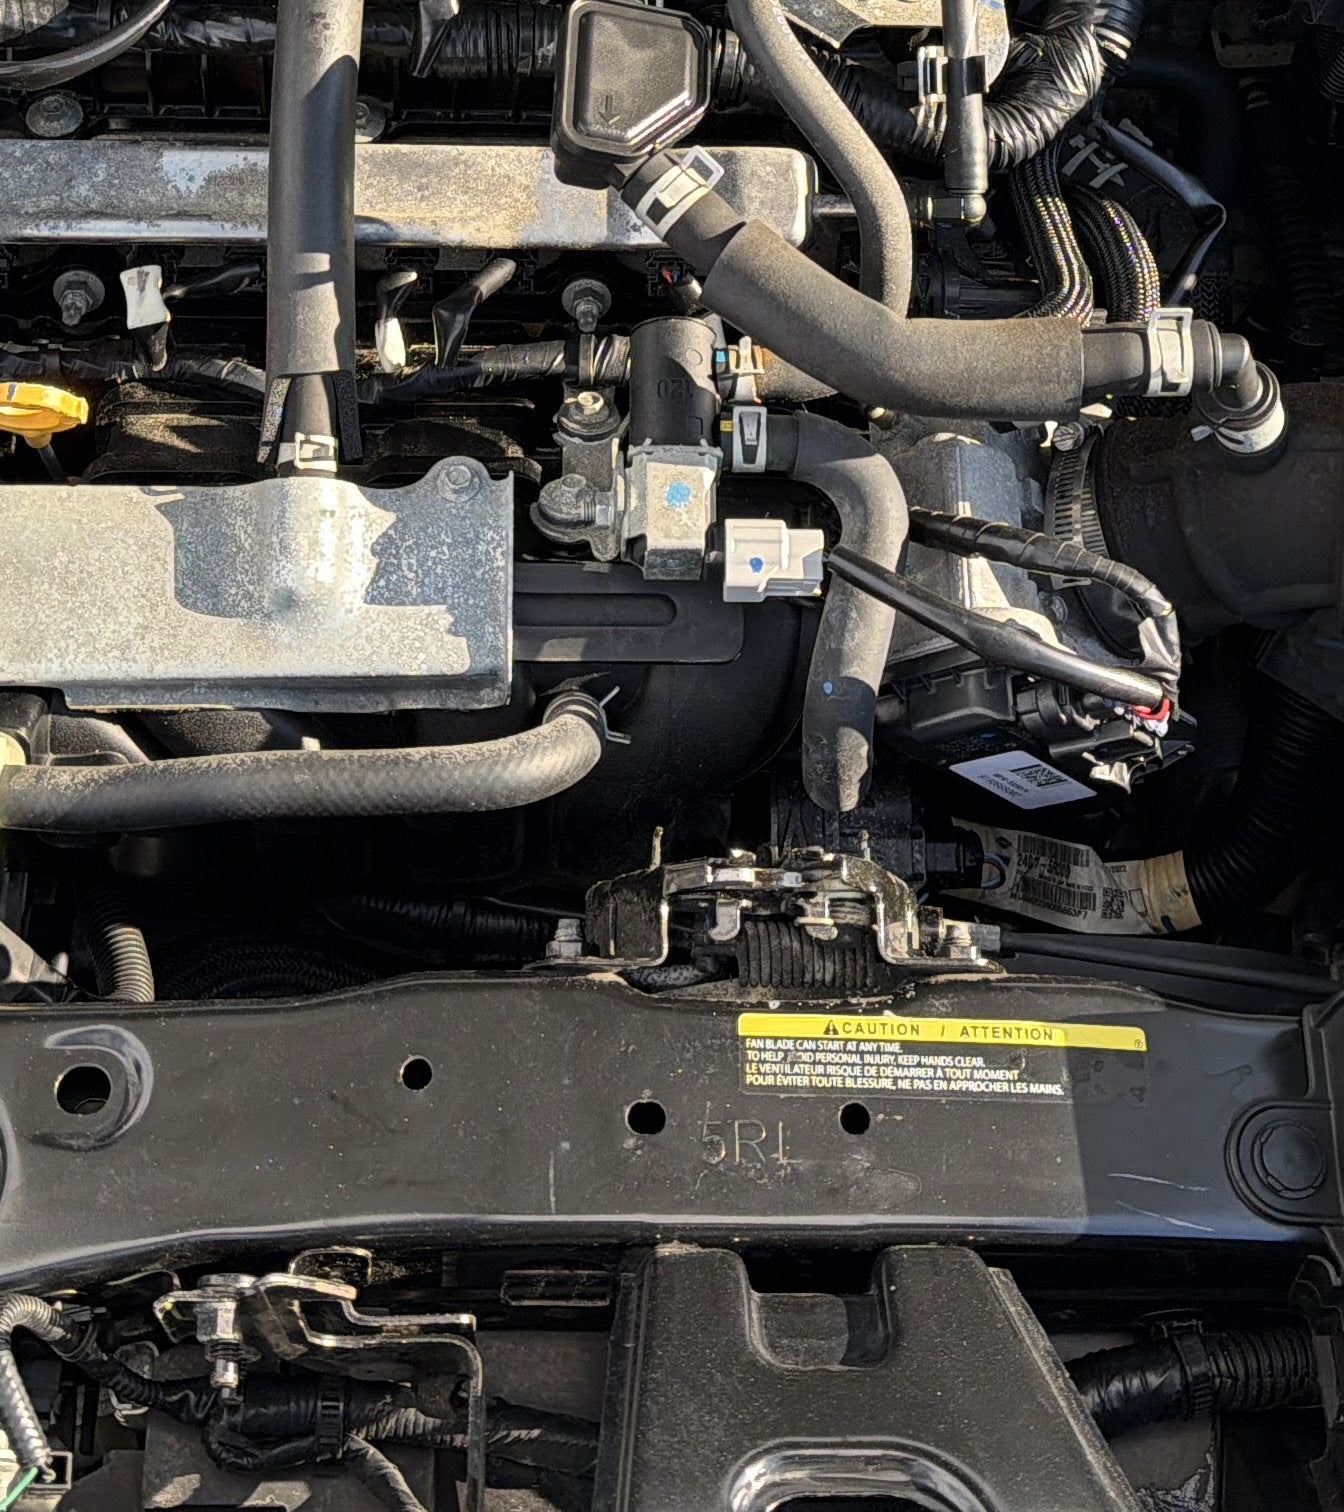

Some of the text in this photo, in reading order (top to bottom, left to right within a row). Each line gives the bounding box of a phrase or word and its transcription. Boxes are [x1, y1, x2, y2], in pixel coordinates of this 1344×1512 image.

[843, 1021, 920, 1036] CAUTION
[960, 1025, 1053, 1040] ATTENTION
[746, 1039, 903, 1053] FAN BLADE CAN START AT ANY TIME.
[747, 1051, 760, 1061] TO
[761, 1051, 784, 1062] HELP
[816, 1053, 862, 1064] PERSONAL
[864, 1054, 896, 1065] INJURY,
[897, 1055, 920, 1065] KEEP
[921, 1056, 954, 1066] HANDS
[955, 1056, 986, 1067] CLEAR.
[746, 1063, 758, 1073] LE
[759, 1064, 825, 1075] VENTILATEUR
[827, 1066, 862, 1076] RISQUE
[864, 1066, 879, 1076] DE
[936, 1068, 943, 1078] À
[944, 1068, 972, 1079] TOUT
[973, 1069, 1020, 1080] MOMENT
[746, 1074, 1064, 1095] POUR ÉVITER TOUTE BLESSURE, NE PAS EN APPROCHER LES MAINS.
